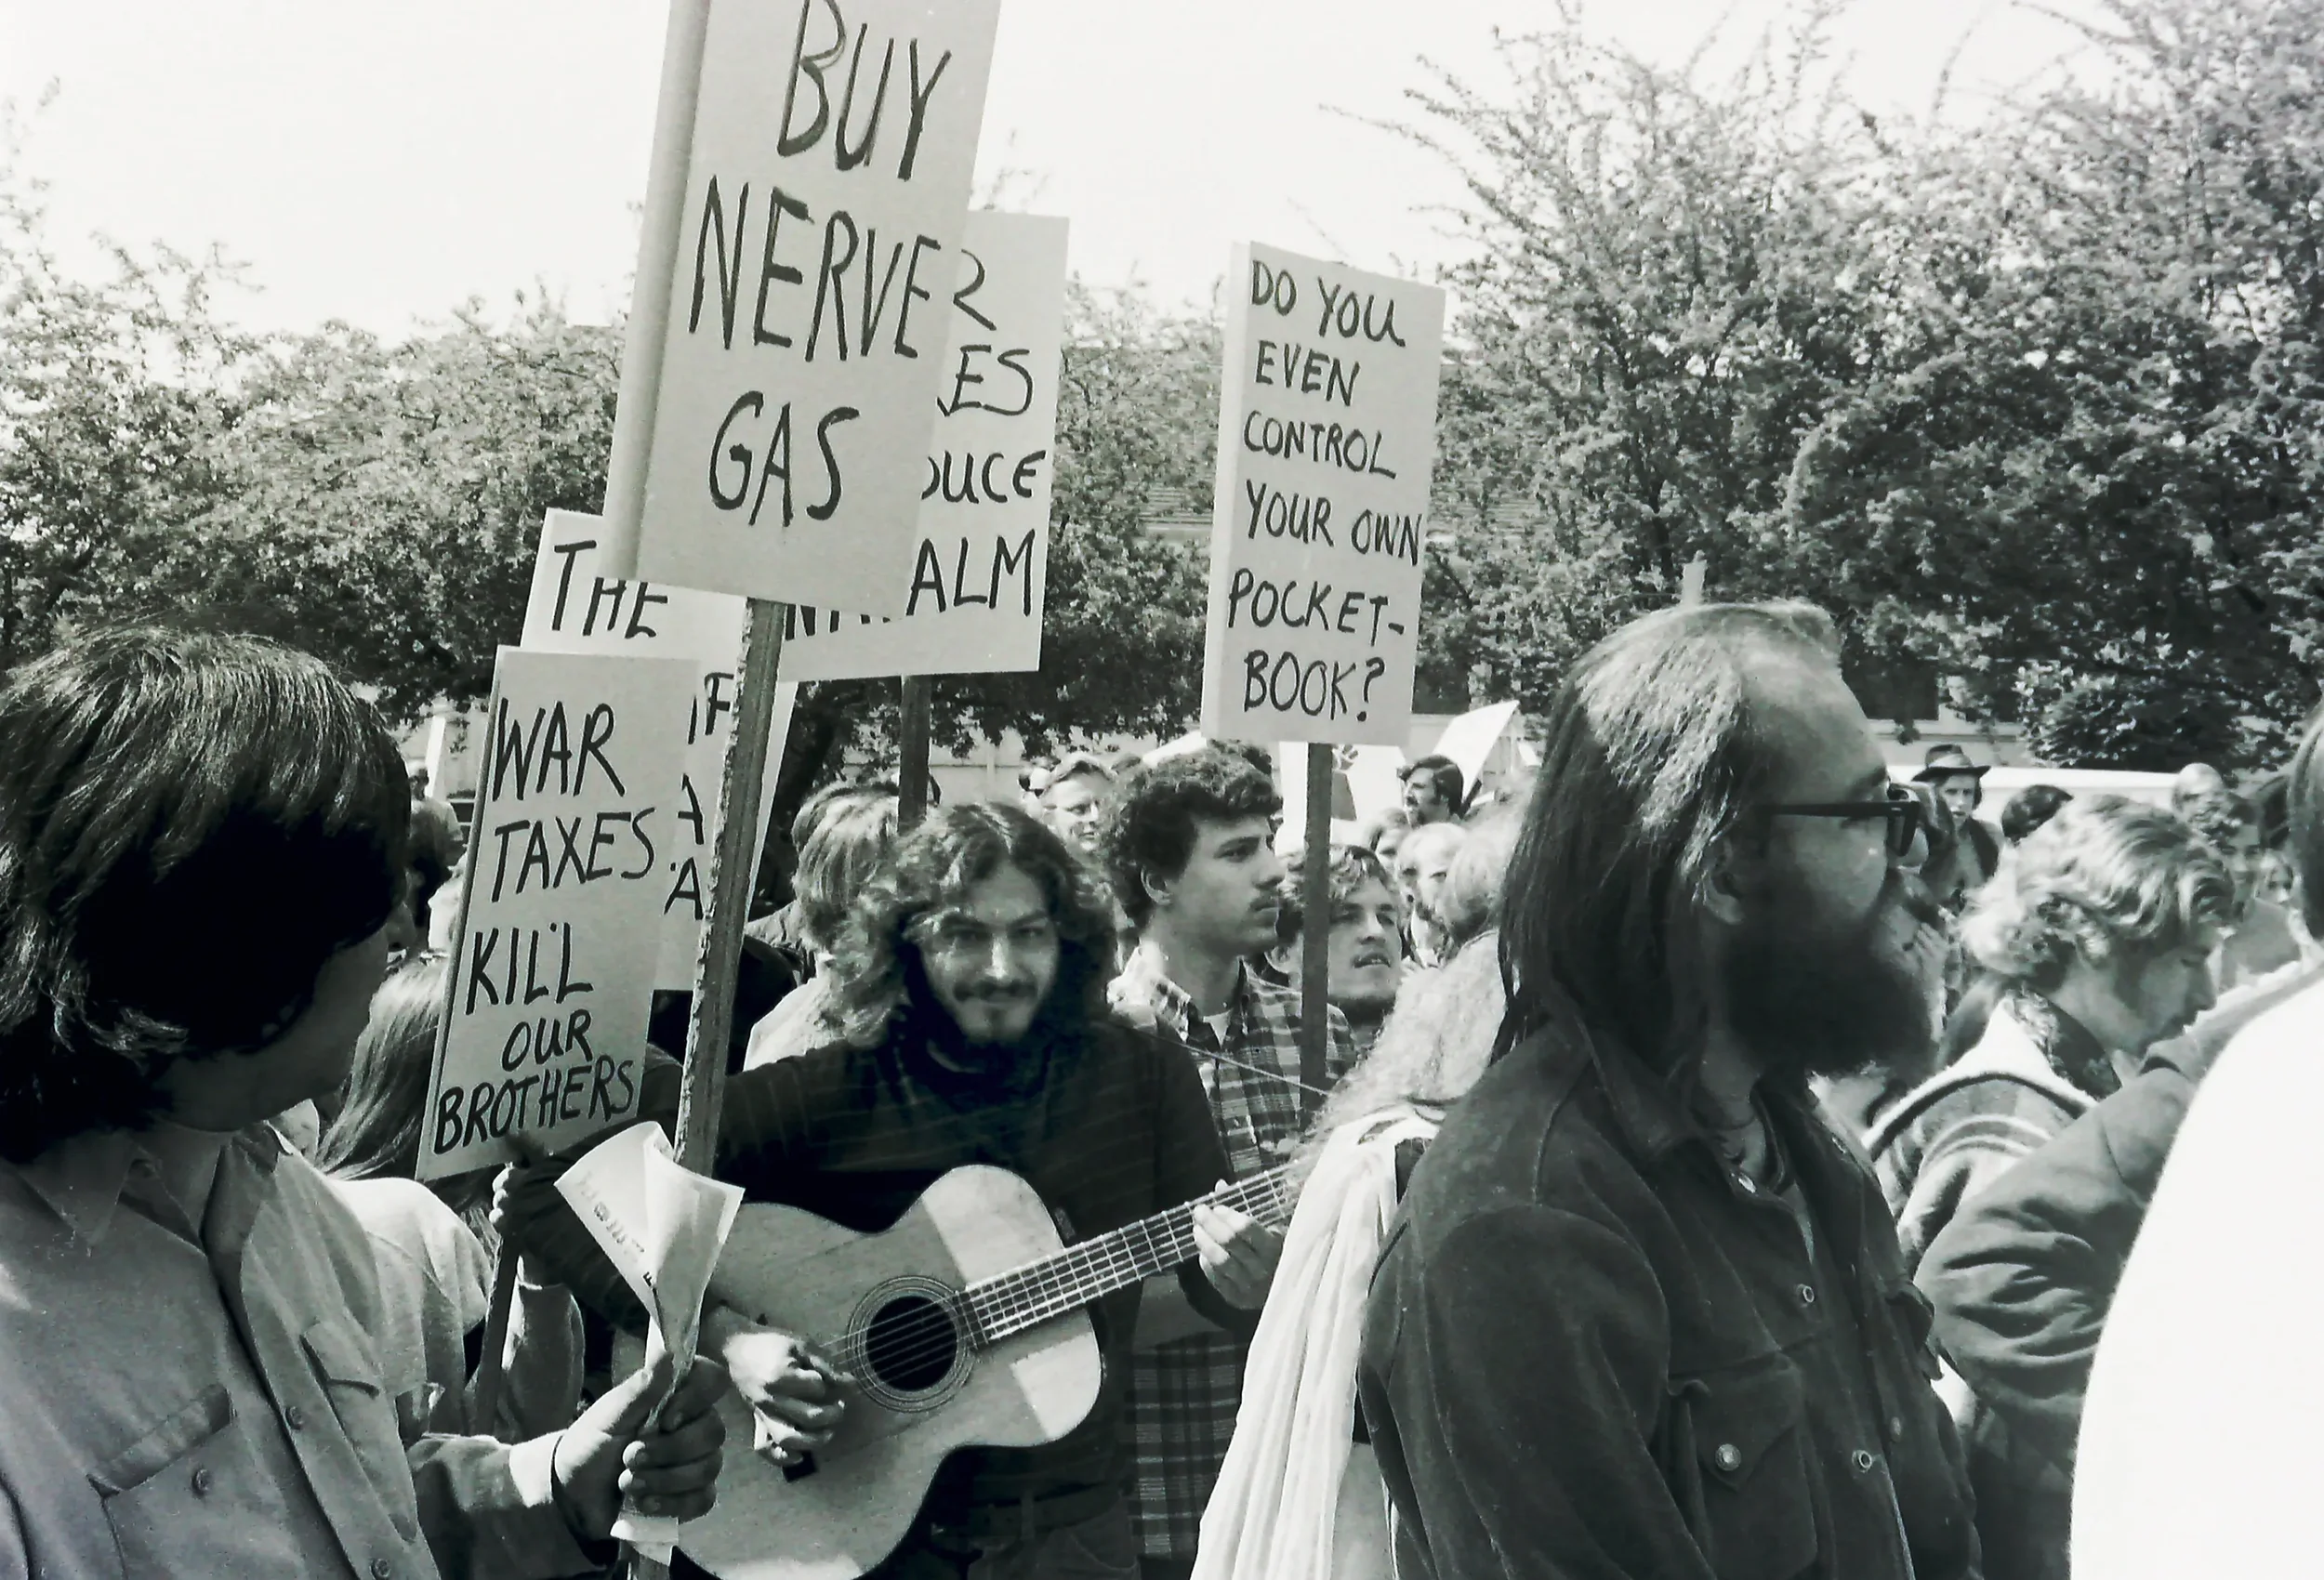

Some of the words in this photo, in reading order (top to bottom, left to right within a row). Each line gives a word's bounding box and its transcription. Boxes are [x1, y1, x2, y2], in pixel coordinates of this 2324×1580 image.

[775, 0, 954, 183] BUY
[686, 173, 943, 363] NERVE
[1249, 258, 1298, 317] DO
[1316, 276, 1406, 348] YOU
[1254, 338, 1361, 407] EVEN
[706, 390, 861, 528] GAS
[1242, 409, 1396, 481] CONTROL
[1245, 478, 1334, 548] YOUR
[1351, 511, 1424, 567] OWN
[550, 539, 669, 639] THE
[1226, 567, 1406, 648] POCKET-
[1243, 648, 1387, 724] BOOK?
[492, 697, 626, 803] WAR
[489, 806, 656, 903] TAXES
[465, 921, 595, 1016] KILL
[500, 1007, 595, 1073] OUR
[432, 1053, 635, 1156] BROTHERS
